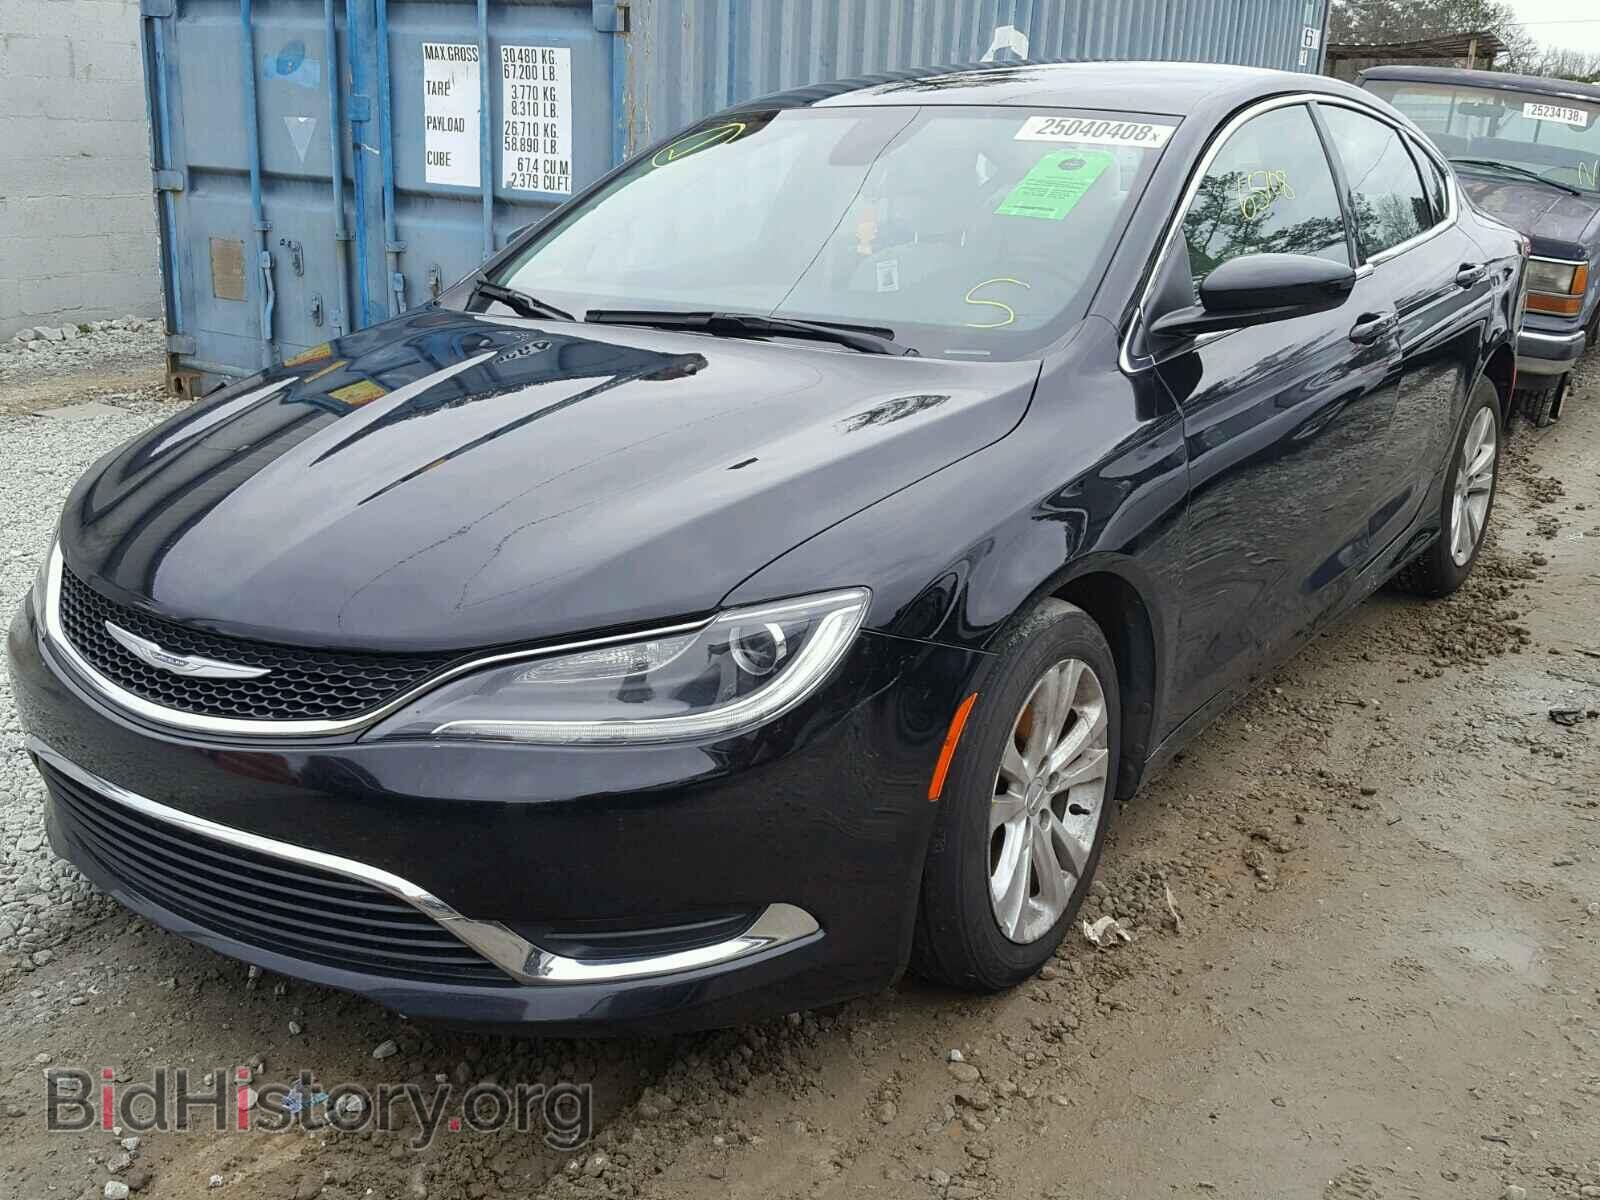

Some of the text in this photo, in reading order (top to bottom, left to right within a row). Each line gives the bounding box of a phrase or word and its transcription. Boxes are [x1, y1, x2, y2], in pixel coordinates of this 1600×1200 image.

[426, 80, 450, 96] TARE
[426, 116, 465, 133] PAYLOAD
[427, 150, 452, 167] CUBE
